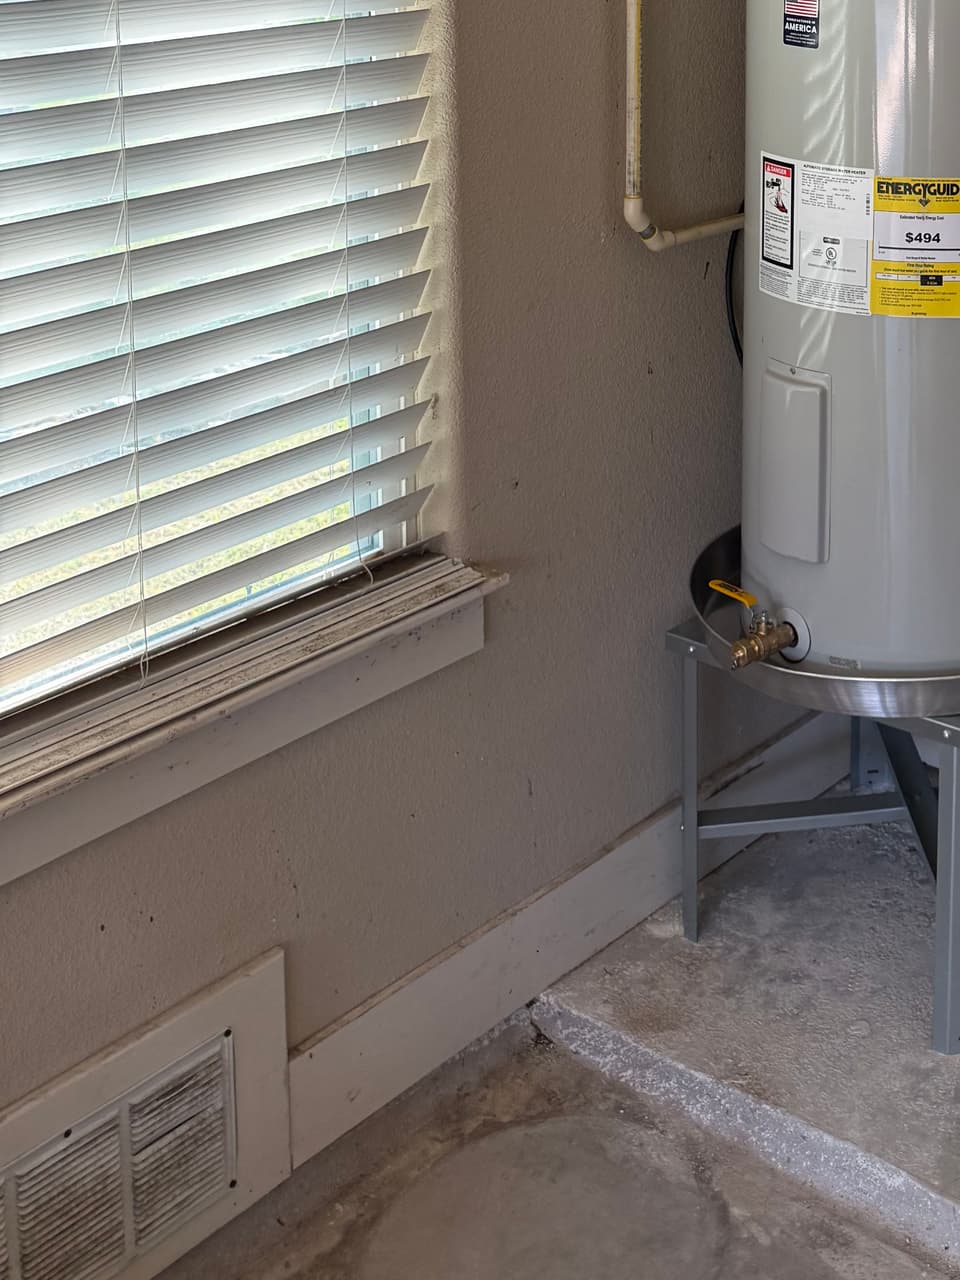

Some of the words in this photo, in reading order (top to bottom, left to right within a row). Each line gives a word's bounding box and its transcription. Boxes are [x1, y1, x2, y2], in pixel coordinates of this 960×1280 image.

[785, 22, 817, 34] AMERICA
[770, 166, 787, 175] DANGER
[905, 232, 941, 244] $494
